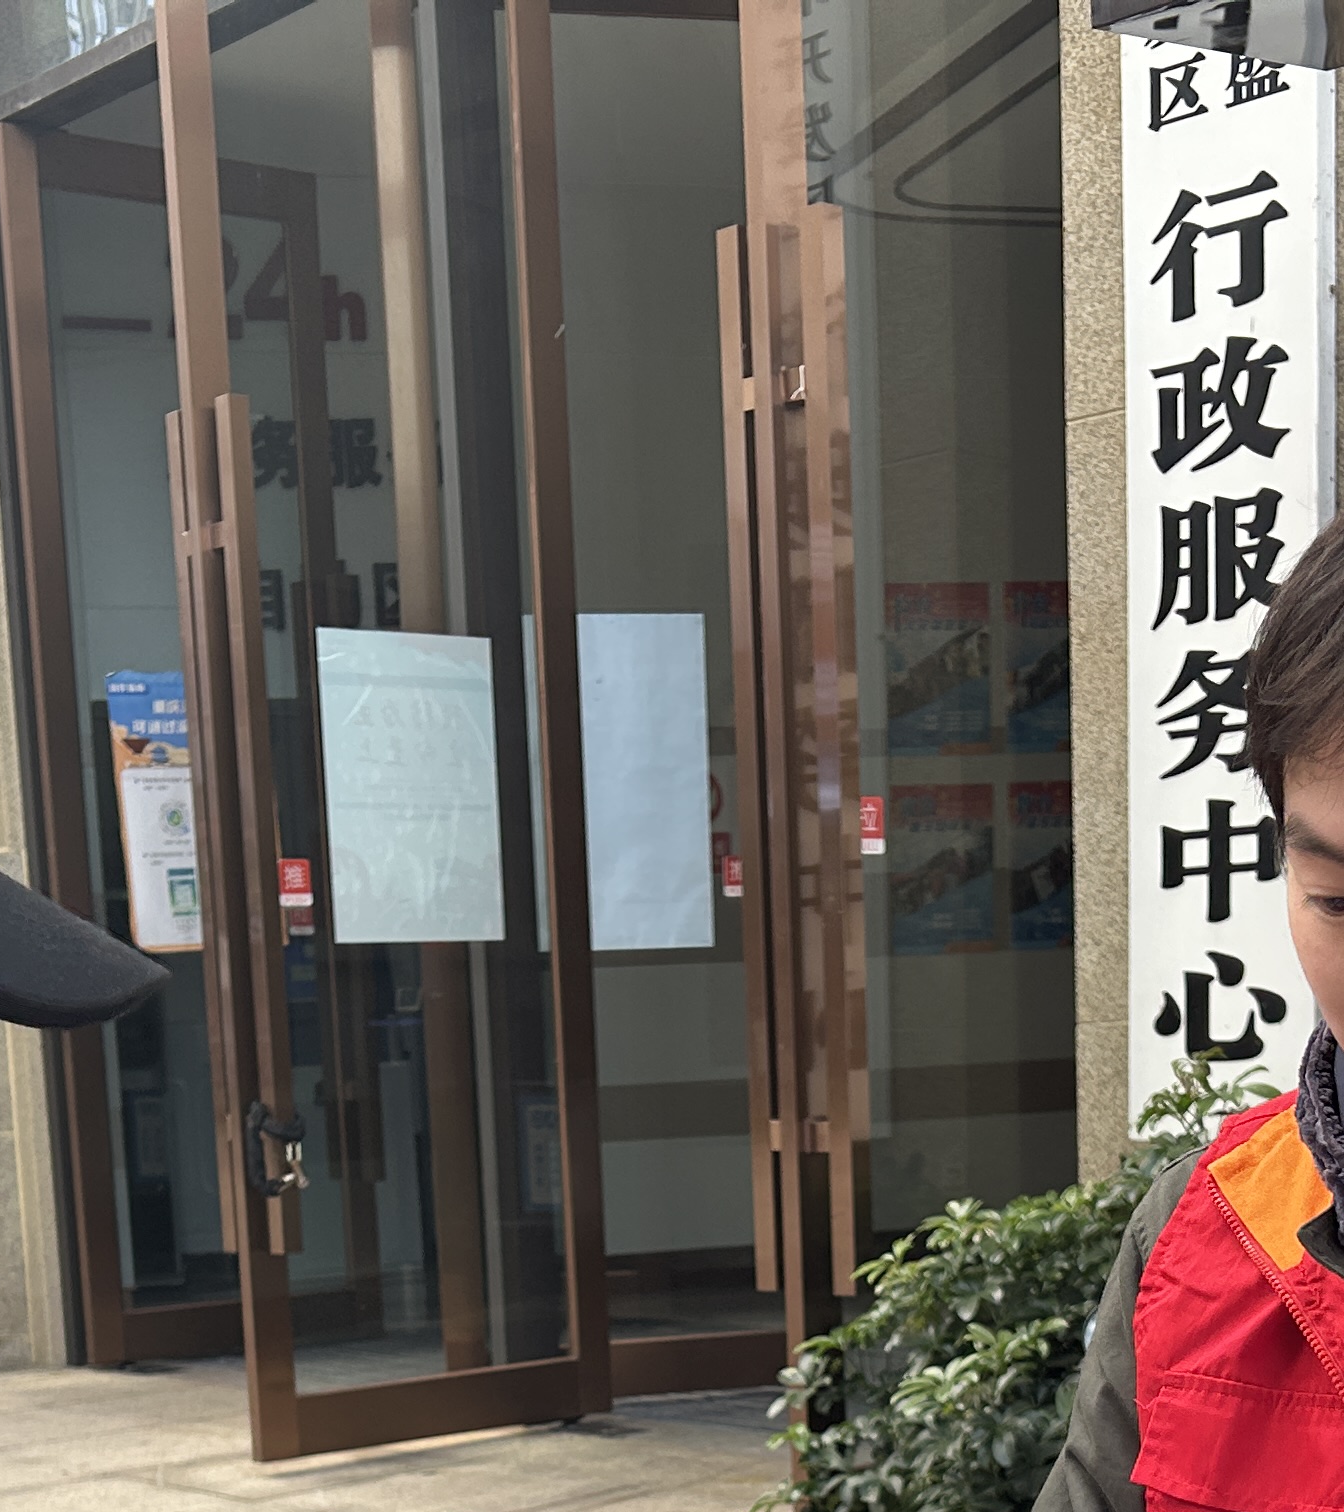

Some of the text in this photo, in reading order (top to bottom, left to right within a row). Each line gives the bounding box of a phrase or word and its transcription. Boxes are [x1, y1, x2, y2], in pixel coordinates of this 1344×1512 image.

[1143, 39, 1208, 132] 区
[1150, 170, 1291, 1062] 行政服务中心
